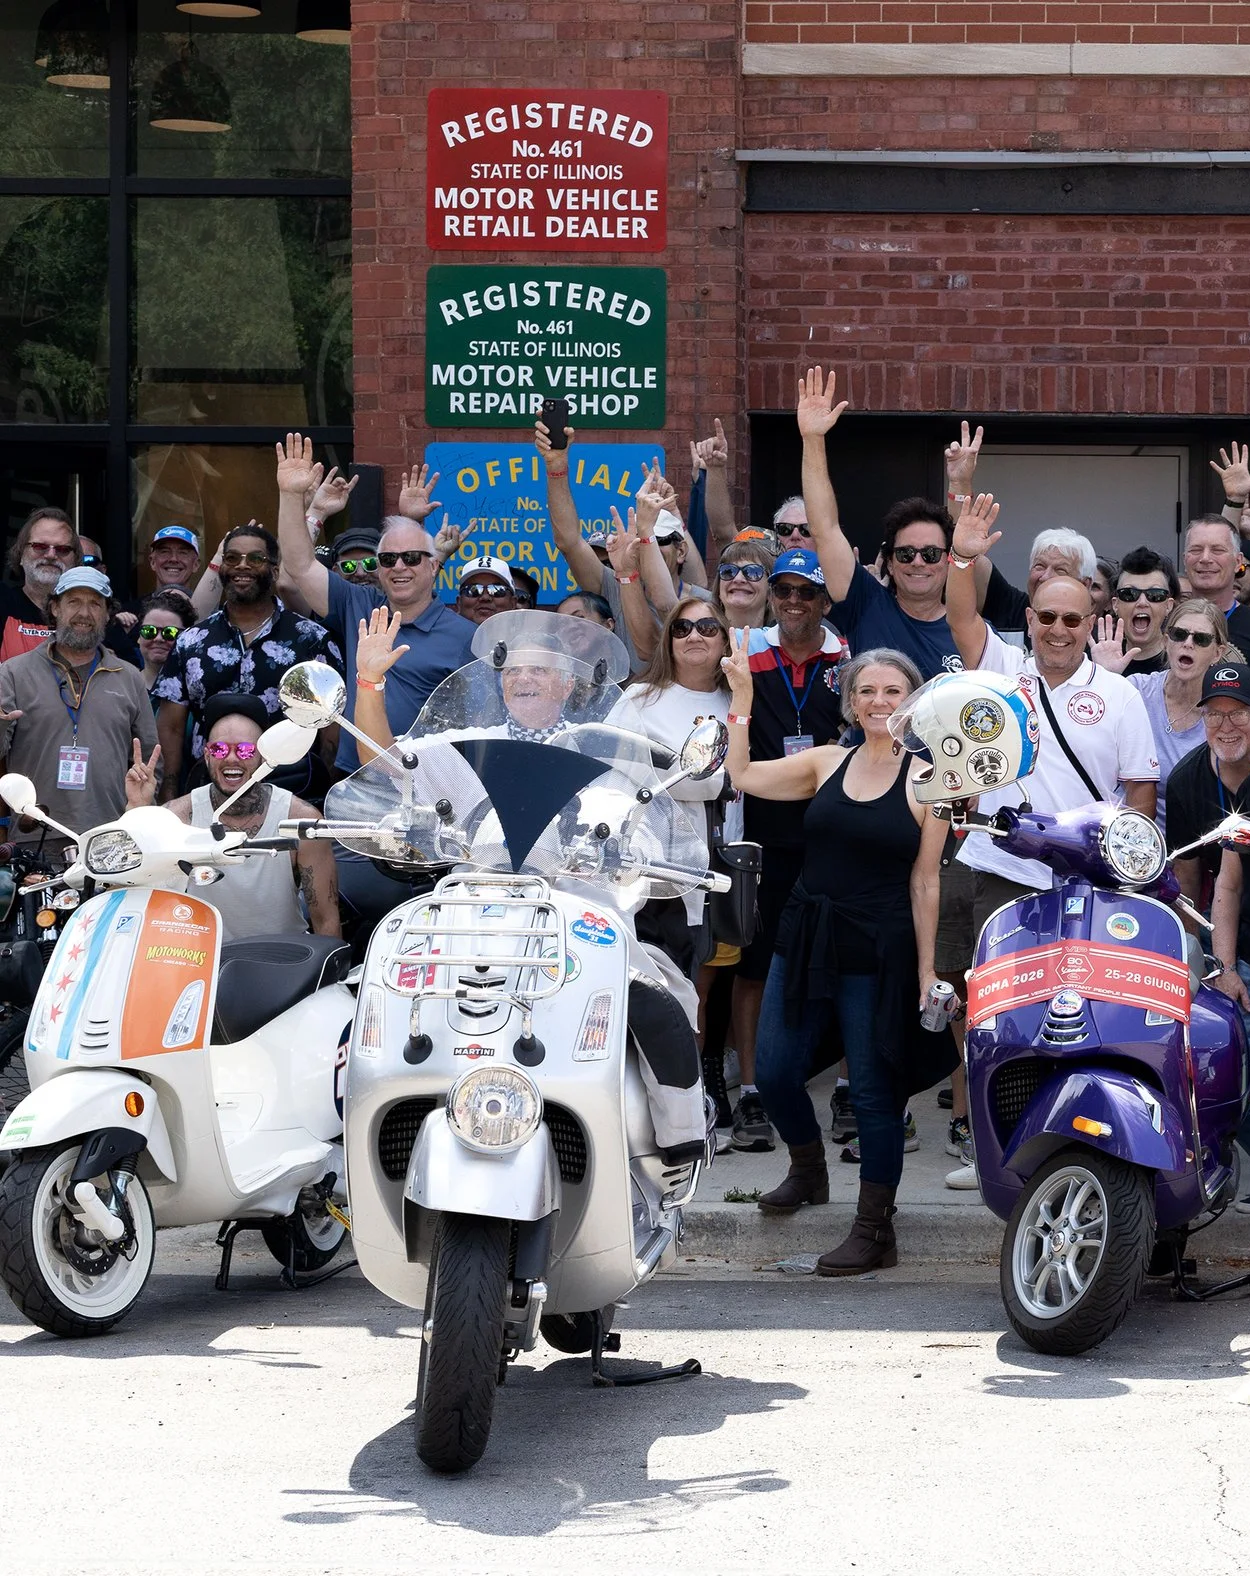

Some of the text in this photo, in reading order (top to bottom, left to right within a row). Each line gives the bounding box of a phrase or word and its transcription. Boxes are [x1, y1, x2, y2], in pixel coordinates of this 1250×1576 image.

[441, 102, 654, 148] REGISTERED
[512, 140, 582, 158] No. 461
[470, 164, 623, 180] STATE OF ILLINOIS
[434, 187, 659, 211] MOTOR VEHICLE
[444, 215, 648, 239] RETAIL DEALER
[439, 280, 651, 327] REGISTERED
[517, 320, 574, 335] No. 461
[469, 341, 621, 358] STATE OF ILLINOIS
[432, 364, 657, 388] MOTOR VEHICLE
[450, 392, 639, 416] REPAIR SHOP
[456, 456, 632, 498] OFFIIAL
[516, 497, 542, 511] No.
[524, 518, 546, 533] OF
[450, 541, 535, 562] OTOR
[1211, 681, 1240, 689] KYMCO
[159, 927, 200, 936] RACING
[1067, 957, 1083, 966] 80
[977, 968, 1044, 1000] ROMA 2026
[1052, 983, 1092, 991] IMPORTANT
[1093, 987, 1122, 997] PEOPLE
[1143, 976, 1186, 998] GIUGNO
[455, 1048, 494, 1057] MARTINI
